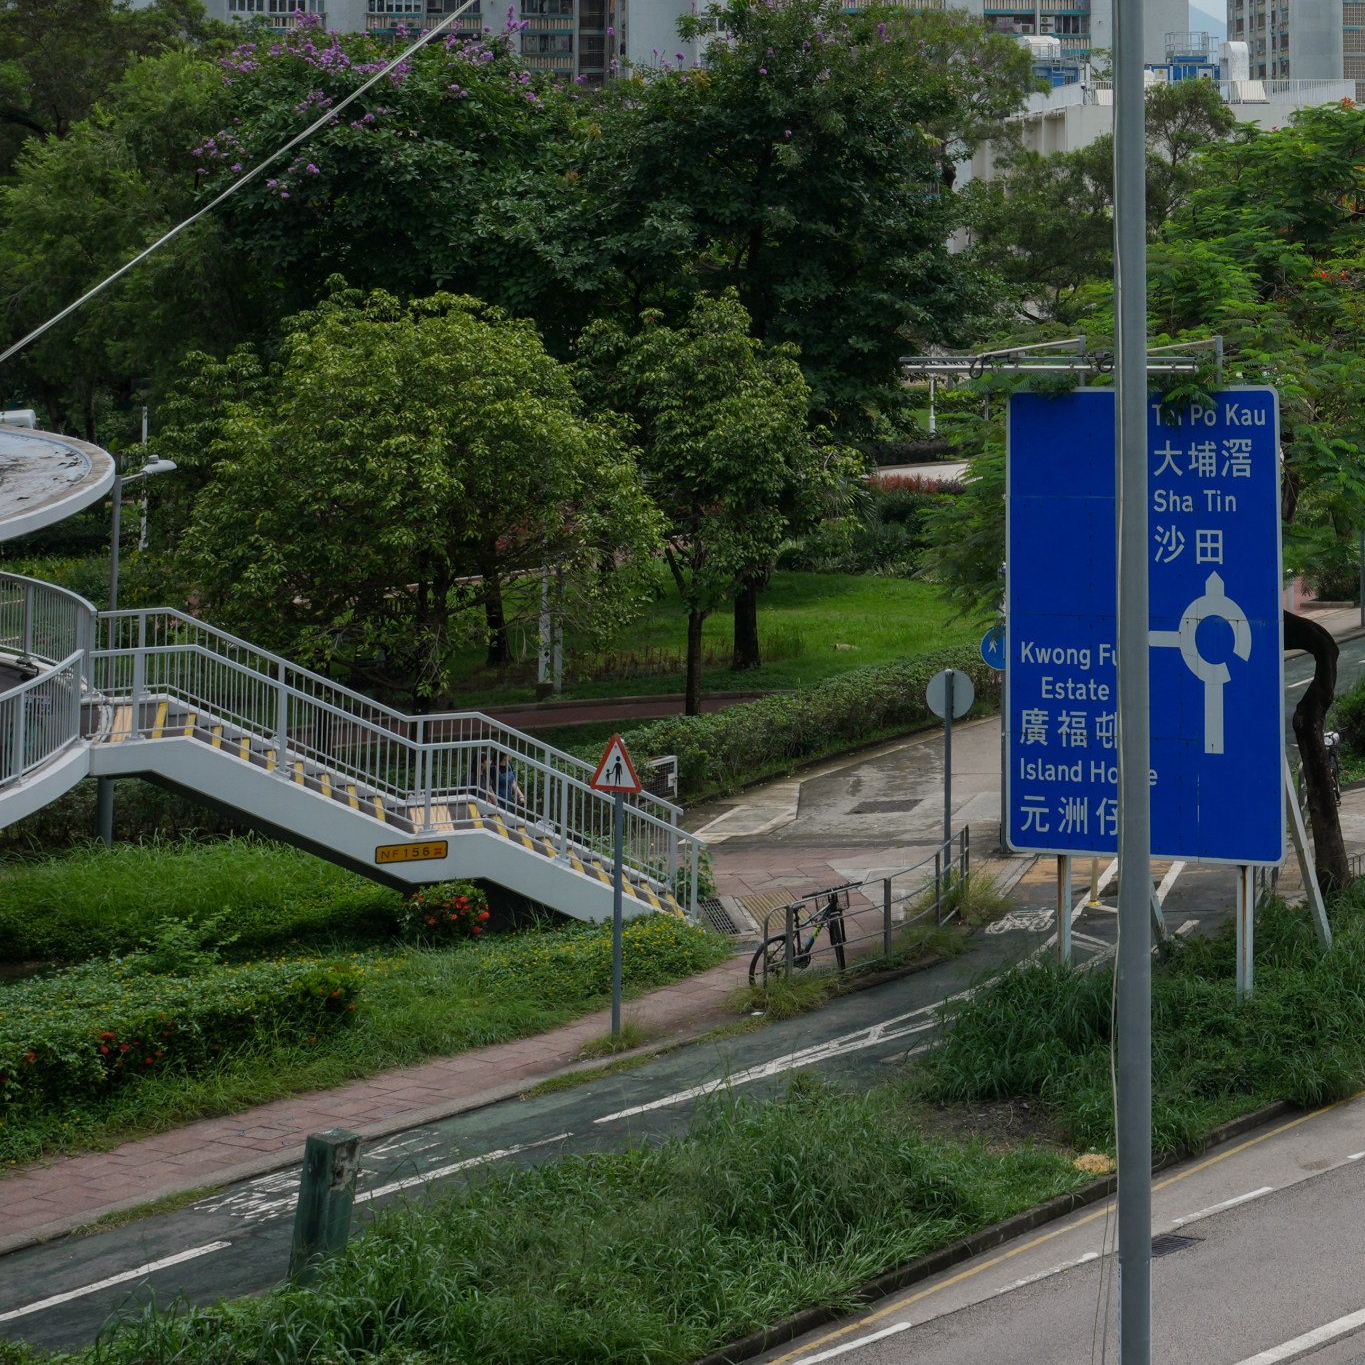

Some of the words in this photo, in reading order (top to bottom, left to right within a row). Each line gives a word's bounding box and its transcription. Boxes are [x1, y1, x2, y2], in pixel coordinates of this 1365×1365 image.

[1152, 404, 1182, 426] Ti
[1191, 404, 1216, 426] Po
[1225, 404, 1266, 426] Kau
[1153, 439, 1252, 478] 大埔滘
[1153, 489, 1193, 512] Sha
[1203, 489, 1236, 512] Tin
[1153, 524, 1223, 565] 沙田
[1021, 641, 1091, 670] Kwong
[1041, 676, 1110, 701] Estate
[1020, 758, 1082, 783] Island
[1090, 761, 1158, 786] Hoe
